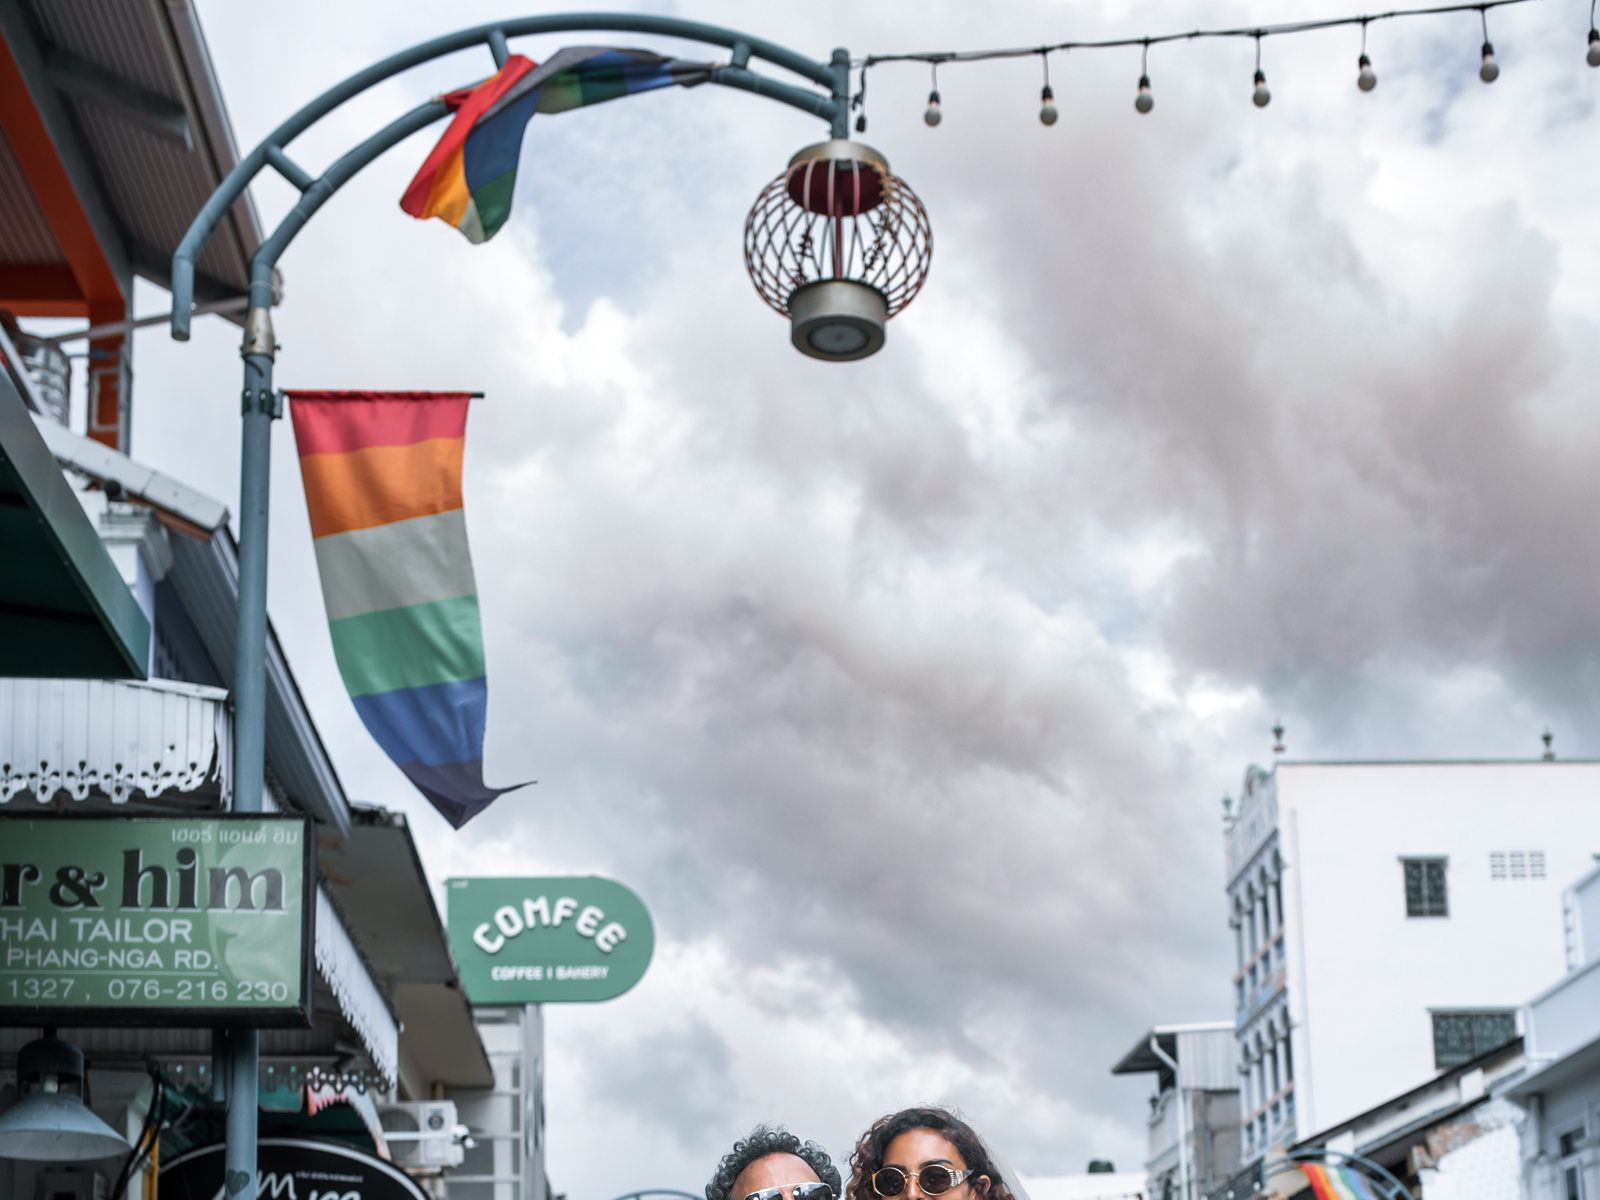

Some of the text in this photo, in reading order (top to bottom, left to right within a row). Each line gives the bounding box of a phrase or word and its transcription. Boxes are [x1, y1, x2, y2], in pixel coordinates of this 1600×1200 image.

[48, 864, 108, 912] &
[119, 846, 289, 914] him
[0, 916, 193, 944] HAI TAILOR
[472, 895, 627, 955] COMFEE
[6, 947, 219, 971] PHANG-NGA RD.
[491, 965, 544, 981] COFFEE
[555, 964, 609, 981] BAKERY
[236, 980, 288, 1002] 230
